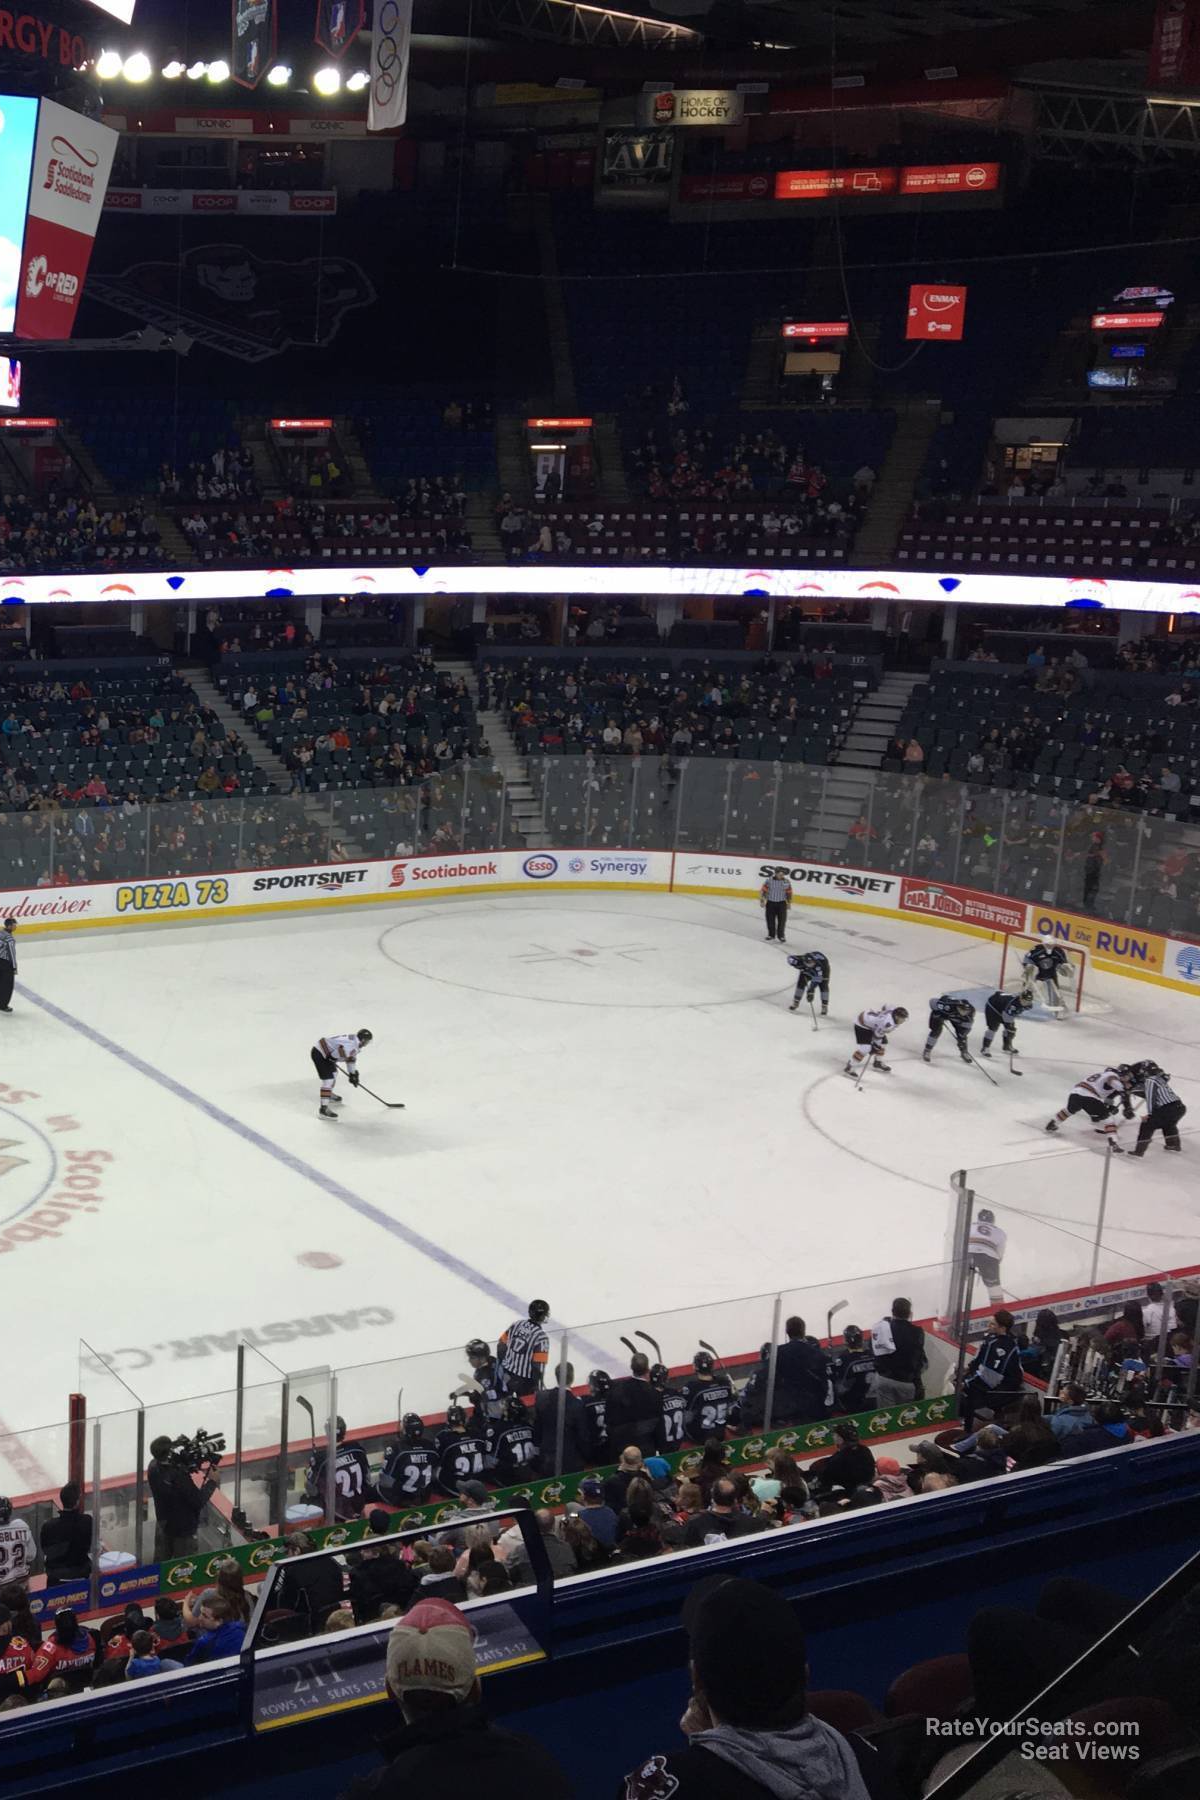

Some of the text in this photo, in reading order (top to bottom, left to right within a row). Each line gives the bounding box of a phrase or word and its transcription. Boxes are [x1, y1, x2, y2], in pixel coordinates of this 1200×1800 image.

[680, 107, 730, 117] HOCKEY
[681, 97, 728, 107] HOME OF
[608, 143, 672, 170] AVI
[57, 161, 94, 187] Scotiabank
[54, 178, 92, 204] Saddledome
[196, 197, 233, 208] CO-OP
[294, 198, 331, 209] CO-OP
[56, 271, 79, 297] RED
[929, 294, 961, 304] ENMAX
[412, 861, 498, 881] Scotiabank
[528, 859, 553, 872] Esso
[591, 859, 648, 875] Synergy
[707, 866, 742, 876] TELUS
[252, 869, 368, 891] SPORTSNET
[116, 878, 228, 911] PIZZA 73
[906, 893, 930, 908] PAPA
[964, 907, 995, 921] BETTER
[1037, 916, 1148, 961] ON the RUN
[402, 1464, 432, 1493] 21
[282, 1656, 344, 1695] 211
[260, 1699, 298, 1718] ROWS
[327, 1683, 362, 1701] SEATS
